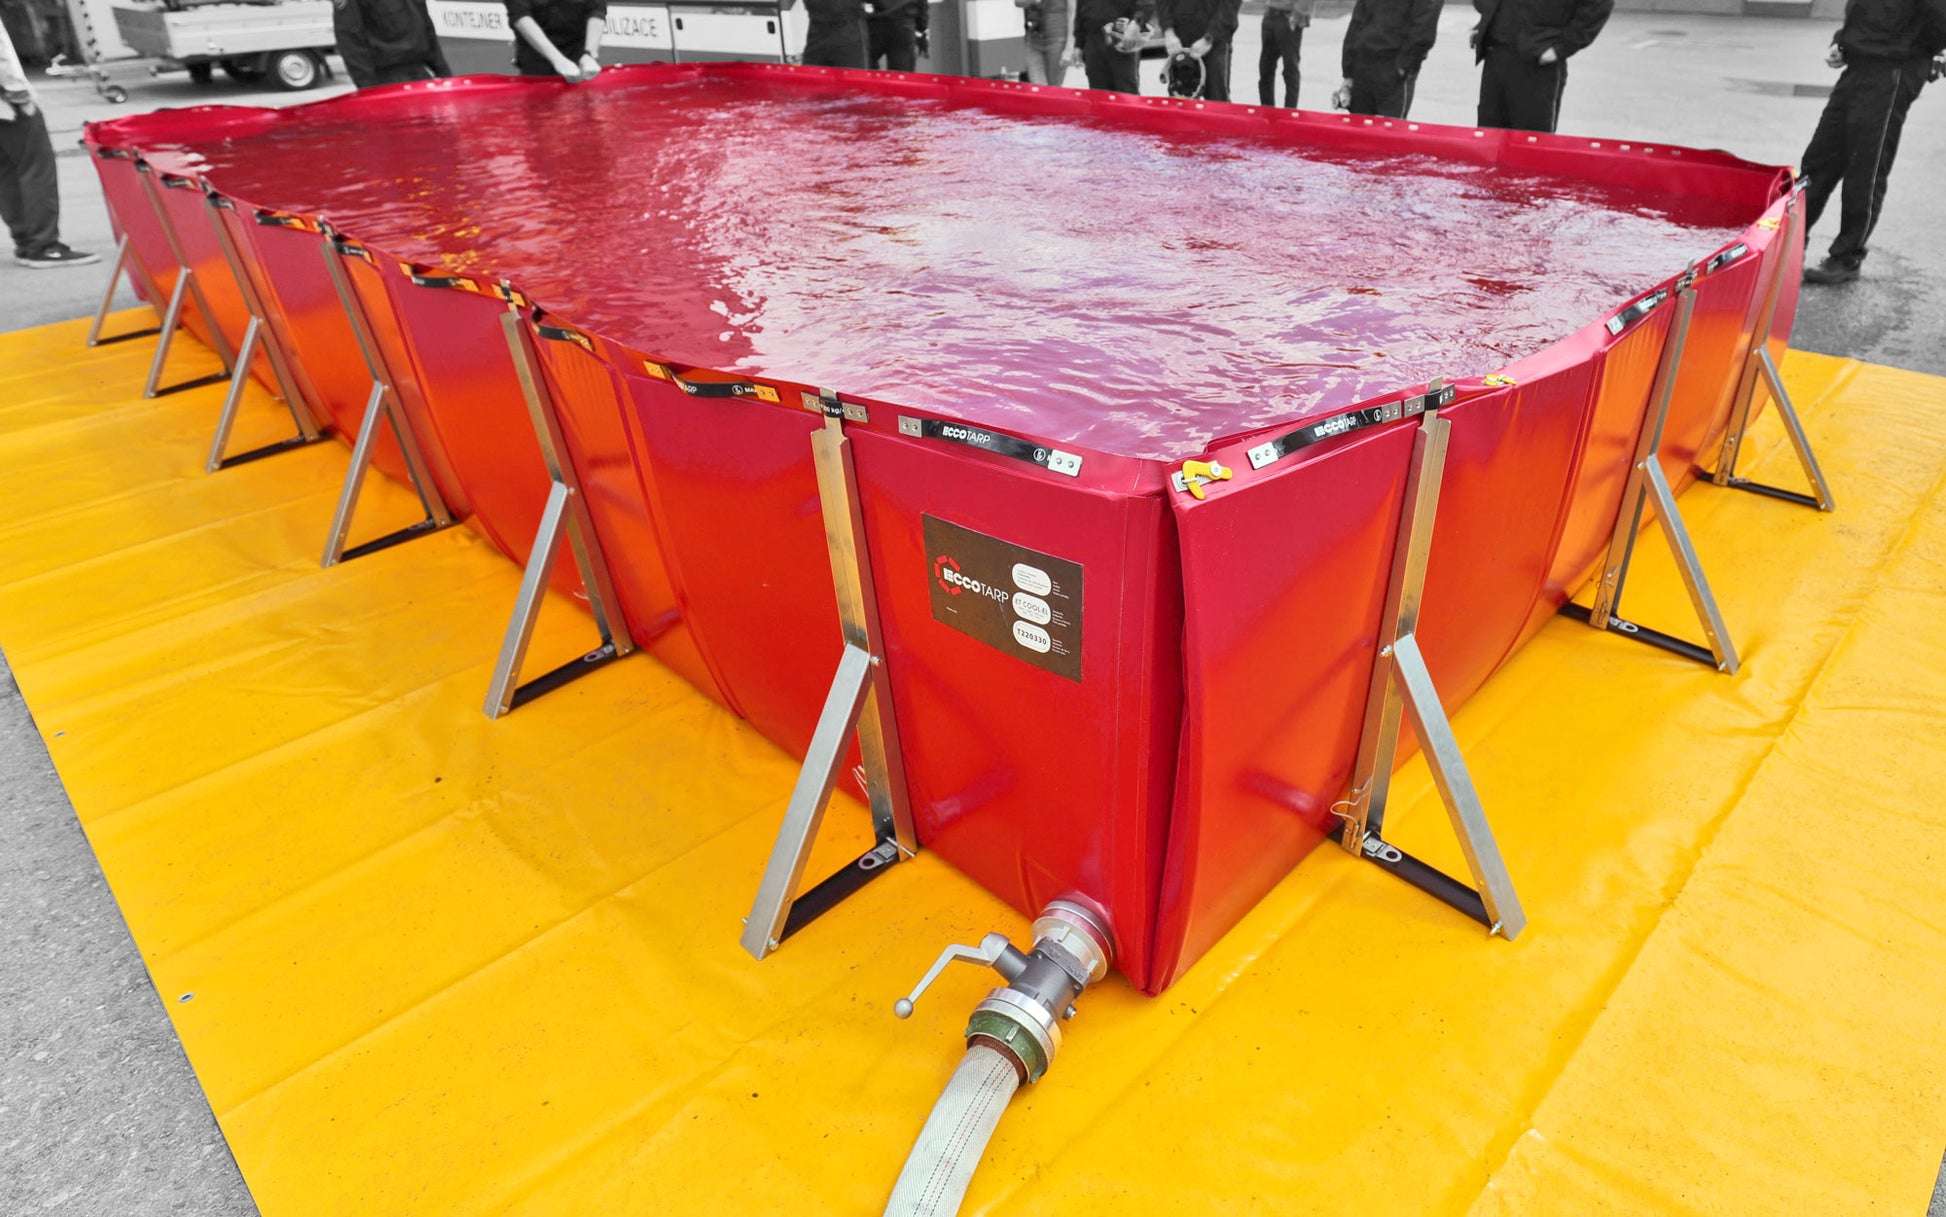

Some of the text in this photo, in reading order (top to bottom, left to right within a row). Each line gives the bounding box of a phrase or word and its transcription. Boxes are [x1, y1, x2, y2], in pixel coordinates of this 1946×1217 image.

[443, 10, 501, 30] KONTEJNER
[942, 425, 991, 444] ECCOTARP
[943, 567, 1009, 603] ECCOTARP
